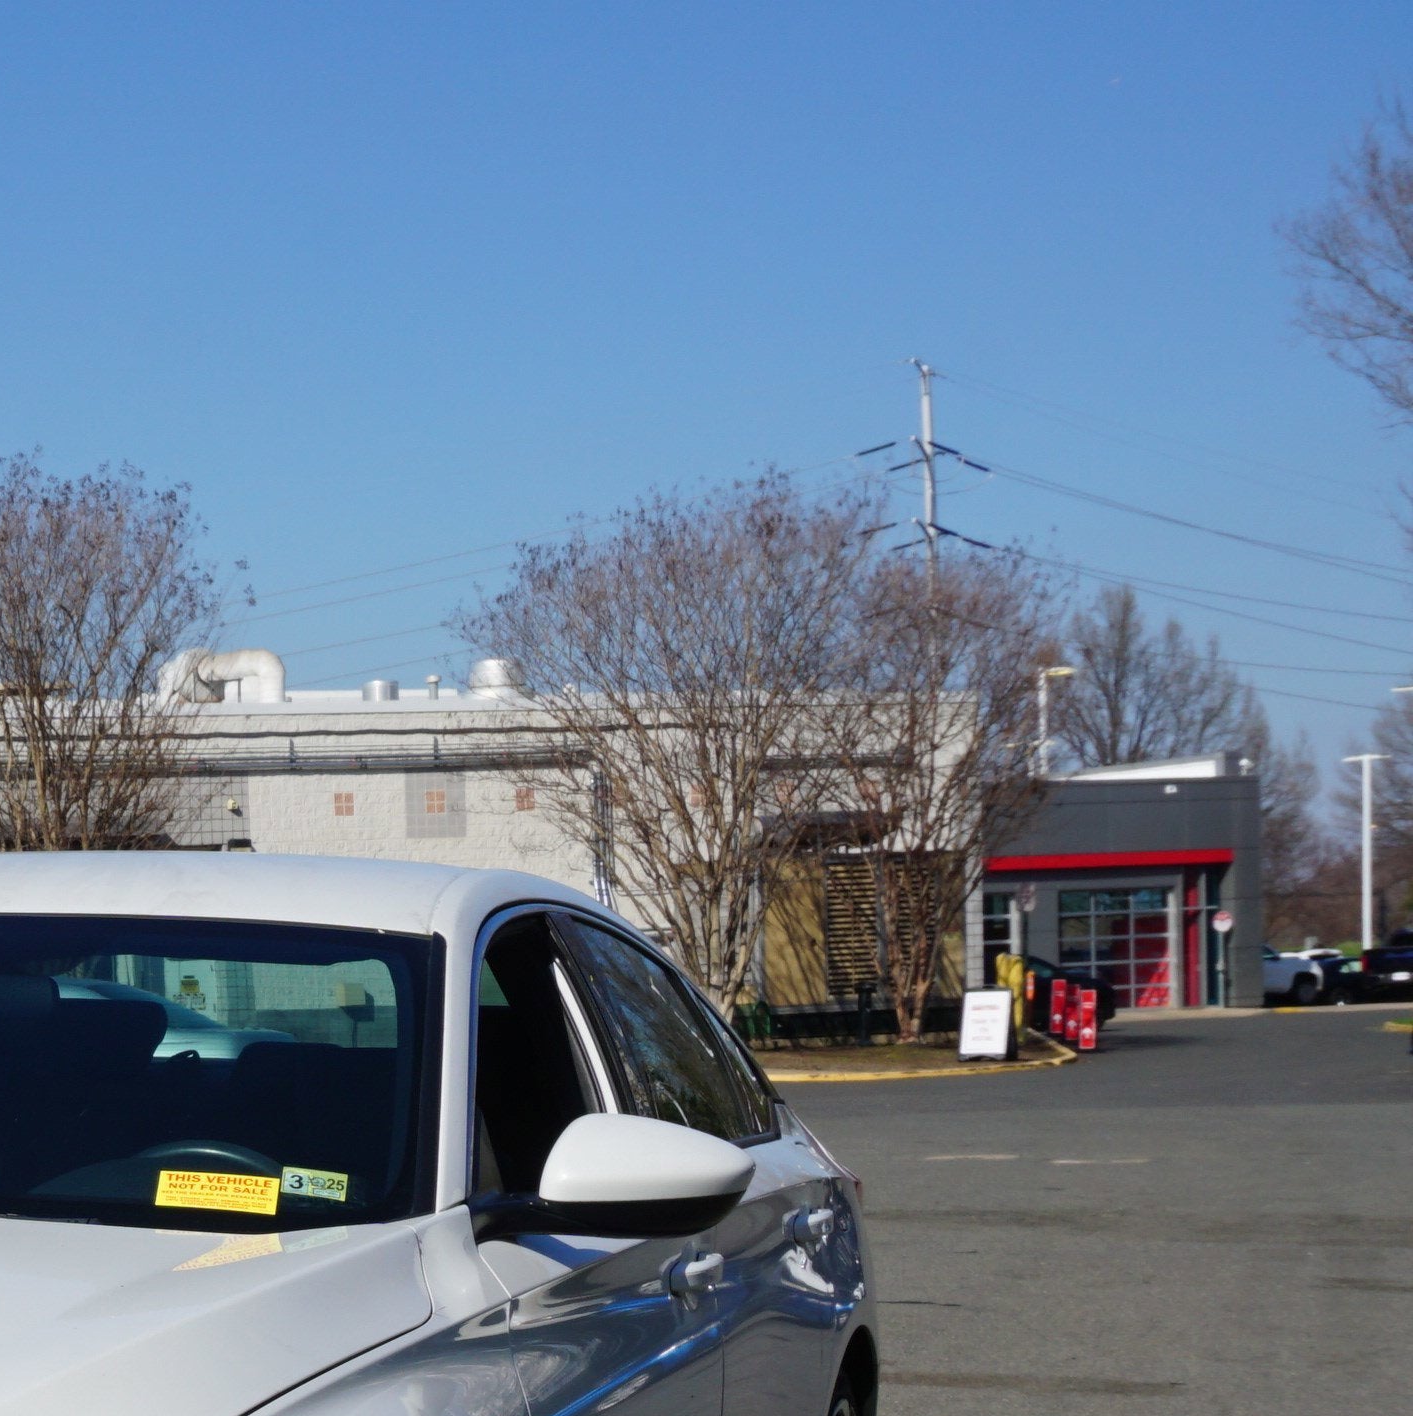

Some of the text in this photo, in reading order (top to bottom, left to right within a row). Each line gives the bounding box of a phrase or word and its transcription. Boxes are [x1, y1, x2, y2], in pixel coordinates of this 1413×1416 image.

[167, 1173, 273, 1188] THIS VEHICLE
[289, 1174, 304, 1190] 3
[326, 1178, 345, 1191] 25
[169, 1182, 269, 1196] NOT FOR SALE
